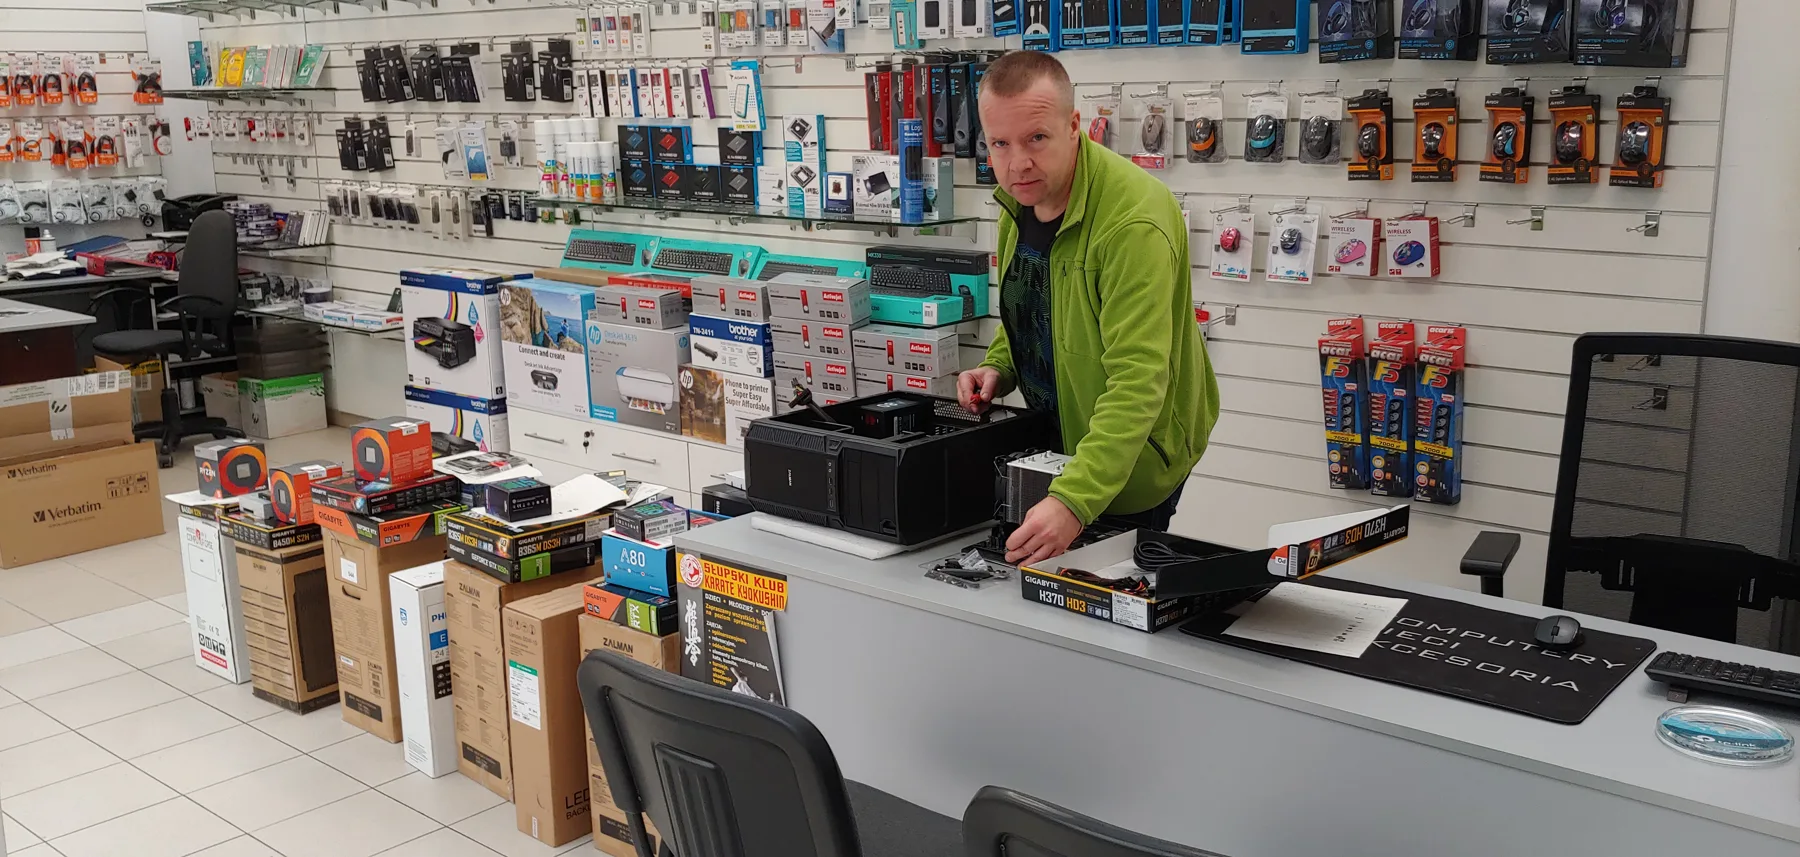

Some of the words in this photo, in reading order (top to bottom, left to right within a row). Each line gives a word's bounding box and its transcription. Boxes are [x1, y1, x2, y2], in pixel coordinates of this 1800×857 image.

[466, 281, 482, 290] brother
[588, 325, 602, 345] hp
[692, 326, 714, 337] TN-2411
[728, 323, 758, 338] brother
[519, 345, 539, 357] Connect
[539, 347, 549, 358] and
[549, 351, 566, 361] create
[1324, 355, 1352, 378] F5
[1373, 359, 1402, 383] F5
[680, 369, 694, 390] hp
[1421, 365, 1452, 388] F5
[725, 378, 743, 390] Phone
[742, 381, 749, 390] to
[749, 383, 769, 394] printer
[470, 399, 487, 408] brother
[732, 388, 749, 400] Super
[748, 392, 762, 403] Easy
[725, 396, 742, 407] Super
[741, 399, 771, 413] Affordable
[1379, 440, 1395, 448] 7000
[1424, 446, 1440, 454] 7000
[17, 463, 58, 478] Verbatim
[200, 466, 216, 477] RYZEN
[48, 500, 102, 522] Verbatim
[318, 511, 343, 527] GIGABYTE
[271, 529, 296, 539] GIGABYTE
[383, 522, 410, 533] GIGABYTE
[447, 521, 465, 532] GIGABYTE
[1363, 516, 1387, 539] H370
[1383, 525, 1406, 541] GIGABYTE
[272, 536, 297, 549] B450M
[296, 533, 310, 544] S2H
[464, 533, 478, 548] DS3H
[518, 534, 544, 545] GIGABYTE
[1344, 528, 1364, 546] HD3
[449, 543, 465, 556] GIGABYTE
[518, 544, 543, 557] B365M
[543, 537, 561, 552] DS3H
[471, 552, 489, 567] GEFORCE
[488, 559, 497, 570] GTX
[620, 547, 645, 567] A80
[704, 562, 749, 585] SŁUPSKI
[754, 576, 784, 594] KLUB
[1024, 575, 1060, 590] GIGABYTE
[458, 582, 481, 598] ZALMAN
[586, 591, 608, 603] GIGABYTE
[704, 575, 735, 596] KARATE
[737, 583, 785, 609] KYOKUSHIN
[705, 593, 721, 603] DZIECI
[728, 600, 754, 613] MŁODZIEŻ
[1038, 589, 1065, 608] H370
[1065, 596, 1086, 613] HD3
[1156, 599, 1179, 611] GIGABYTE
[632, 602, 641, 629] RTX
[705, 603, 732, 616] Zapraszamy
[1155, 614, 1169, 627] H370
[602, 637, 634, 654] ZALMAN
[1383, 628, 1461, 649] IECI
[1396, 617, 1627, 669] OMPUTERY
[435, 649, 445, 659] 24
[1372, 640, 1580, 692] KCESORIA
[1717, 740, 1756, 748] tp-link
